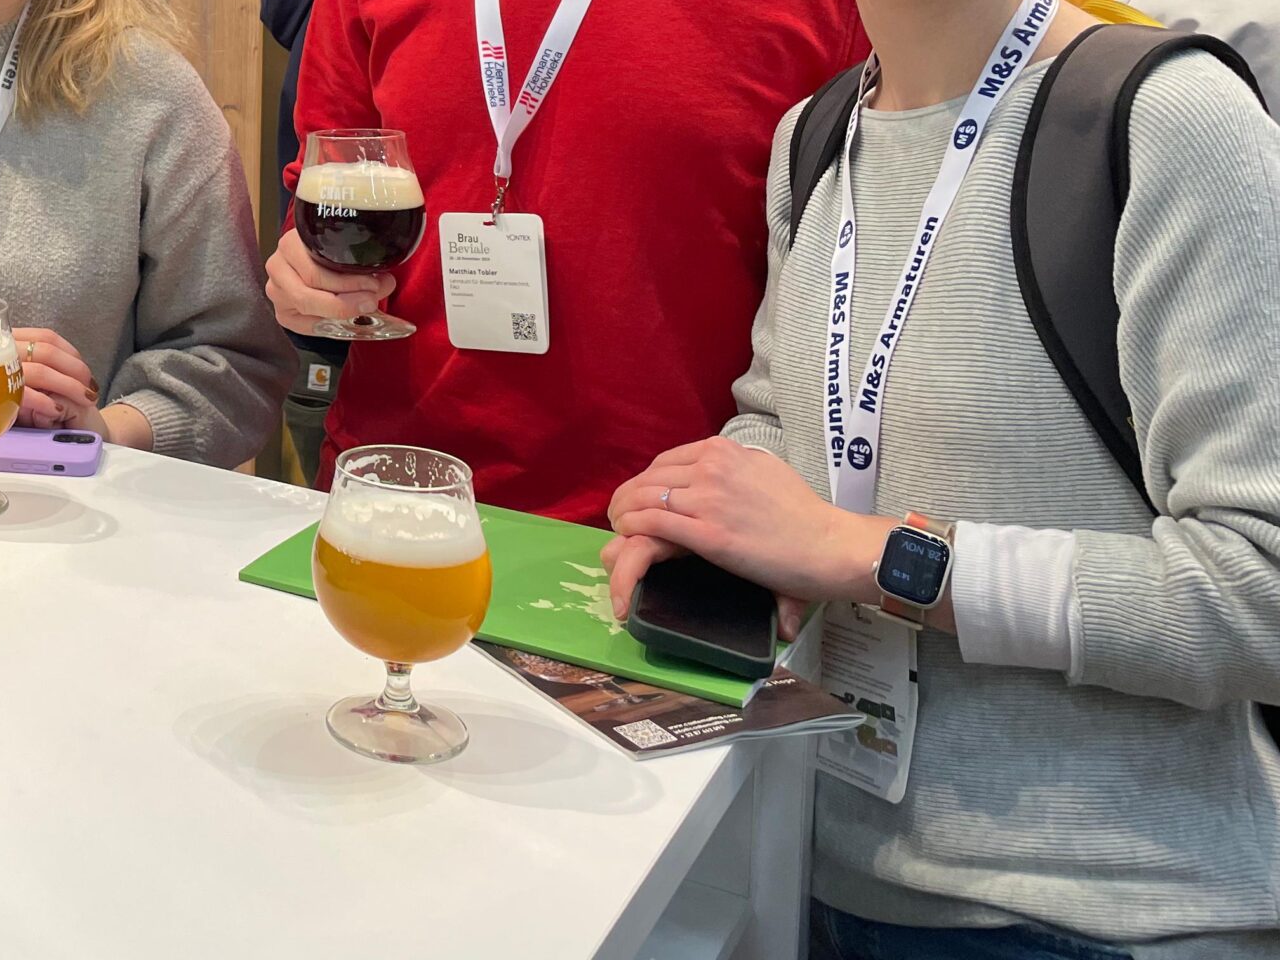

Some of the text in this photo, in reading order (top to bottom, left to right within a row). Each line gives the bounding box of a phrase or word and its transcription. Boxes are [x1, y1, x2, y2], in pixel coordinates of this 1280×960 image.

[483, 61, 497, 108] Holvrieka
[494, 61, 506, 107] Ziemann
[525, 48, 553, 92] Ziemann
[533, 51, 564, 96] Holvrieka
[977, 45, 1023, 98] M&S
[317, 201, 357, 218] Helden
[448, 241, 490, 255] Beviale
[457, 233, 479, 243] Brau
[832, 271, 850, 326] M&S
[859, 216, 939, 413] M&S Armaturen
[849, 441, 872, 467] M&S
